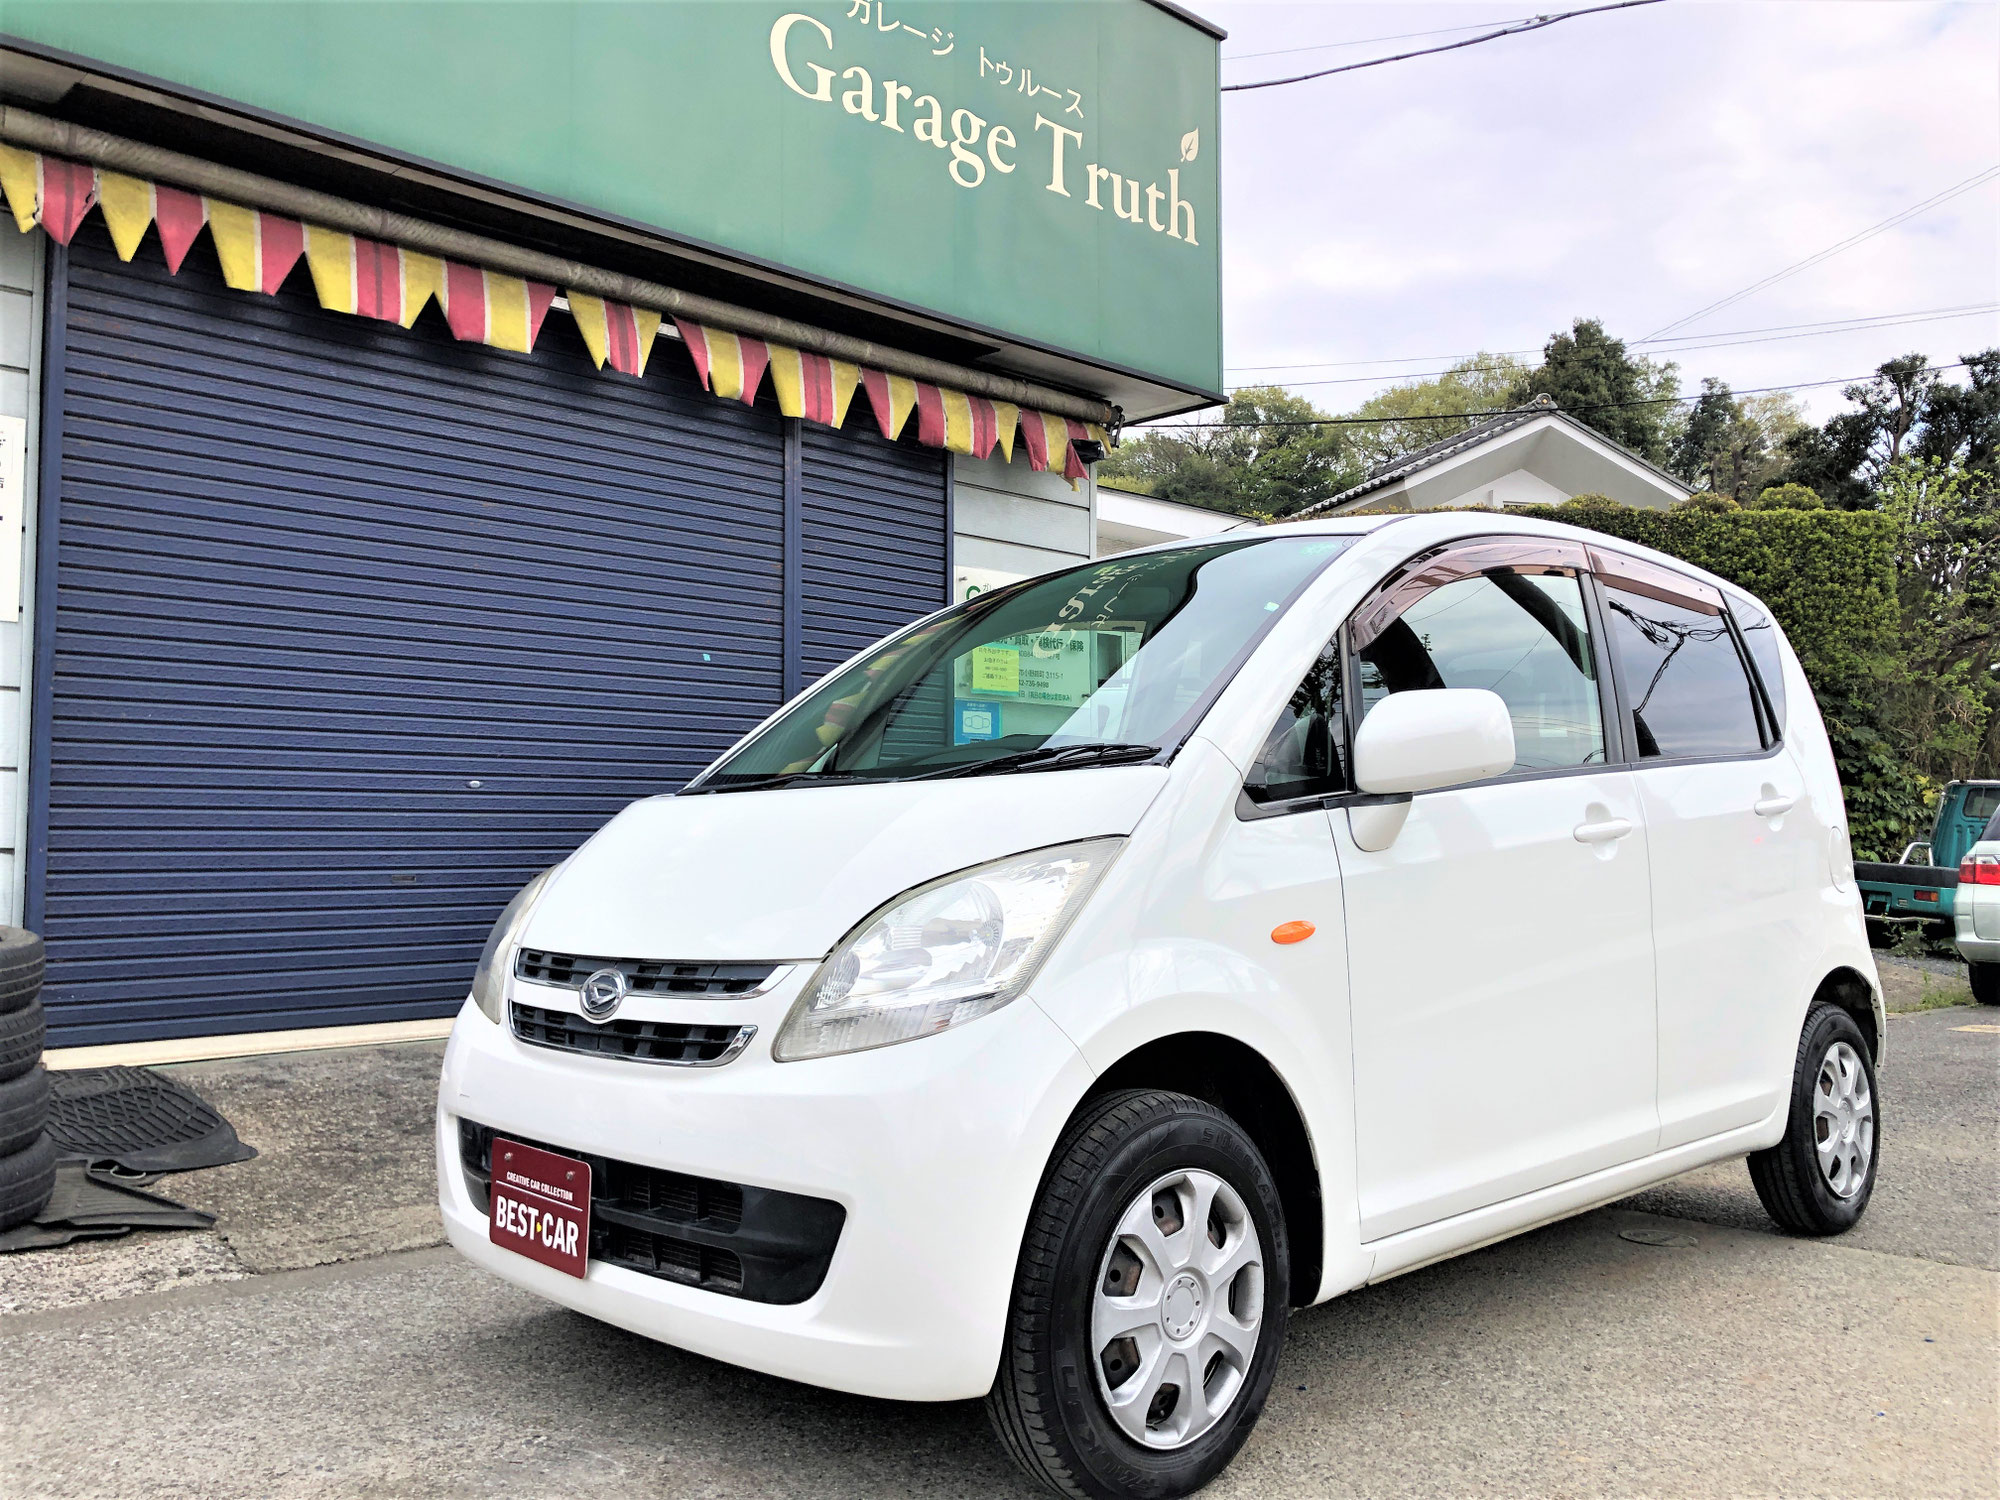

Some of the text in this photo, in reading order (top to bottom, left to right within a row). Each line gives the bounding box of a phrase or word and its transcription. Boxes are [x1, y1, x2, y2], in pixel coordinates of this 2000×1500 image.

[847, 0, 1085, 119] ガレージ トゥルース
[769, 12, 1199, 247] Garage Truth
[495, 1195, 579, 1257] BEST CAR
[506, 1171, 573, 1201] CREATIVE CAR COLLECTION
